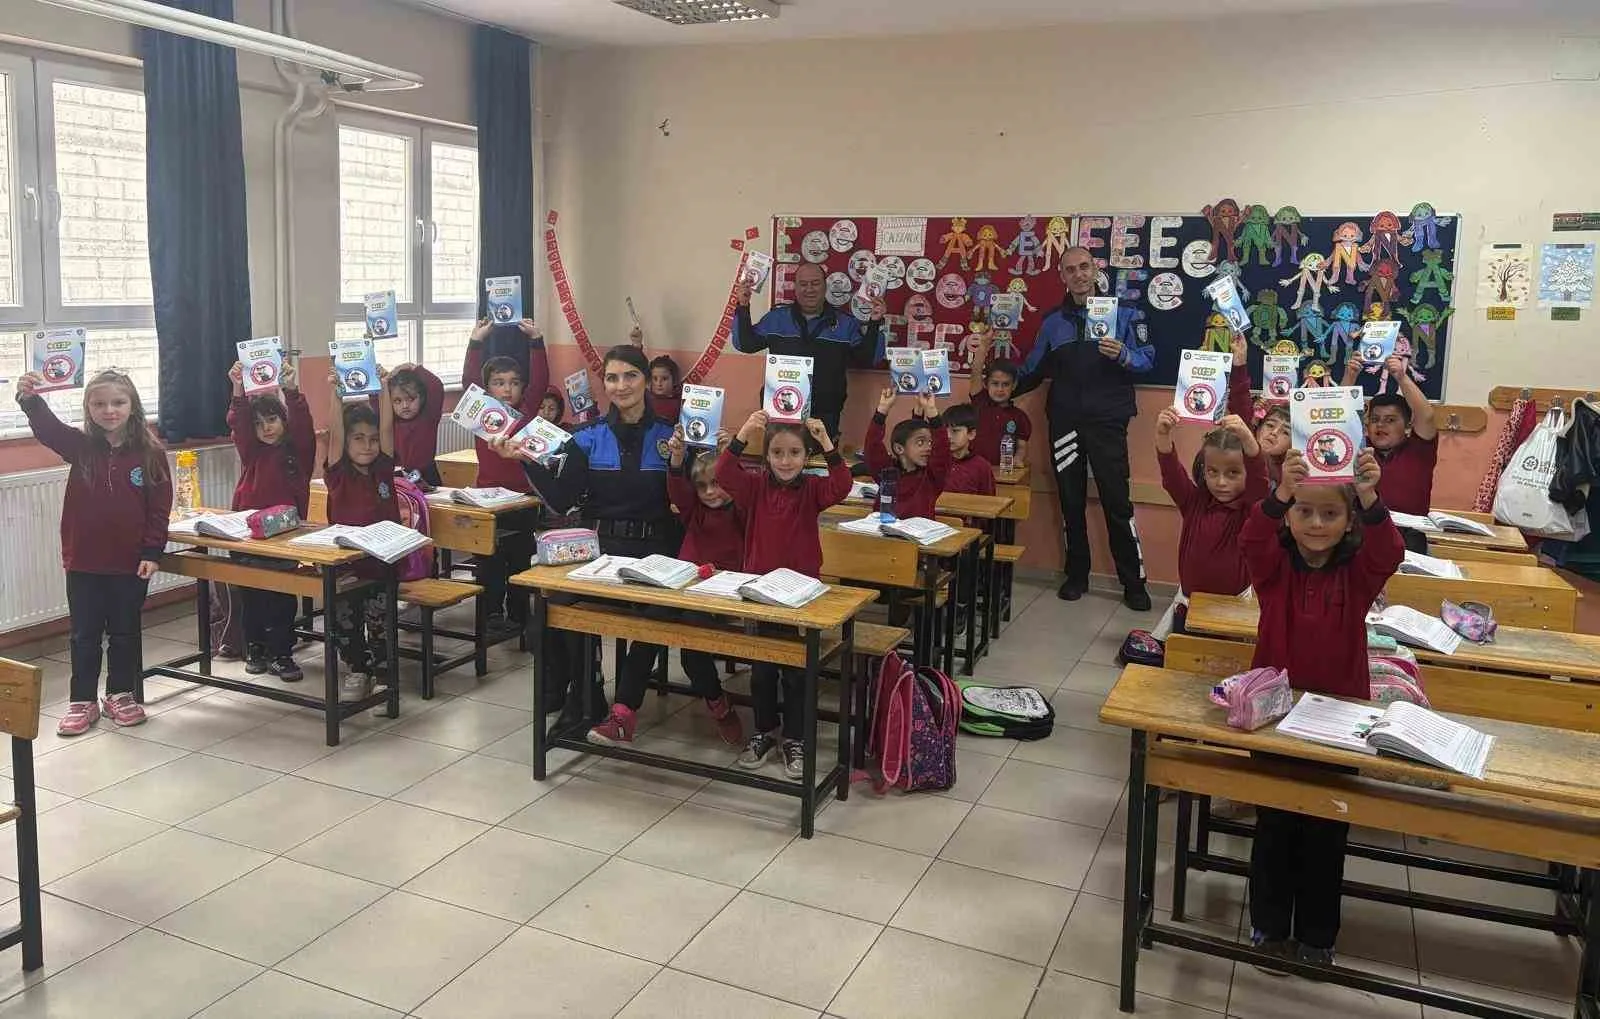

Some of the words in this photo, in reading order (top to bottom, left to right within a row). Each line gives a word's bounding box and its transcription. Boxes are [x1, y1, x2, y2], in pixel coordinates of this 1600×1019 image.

[1110, 215, 1146, 269] E
[1150, 216, 1184, 269] E
[1182, 240, 1217, 278] e
[906, 258, 936, 293] e
[1148, 272, 1184, 310] e
